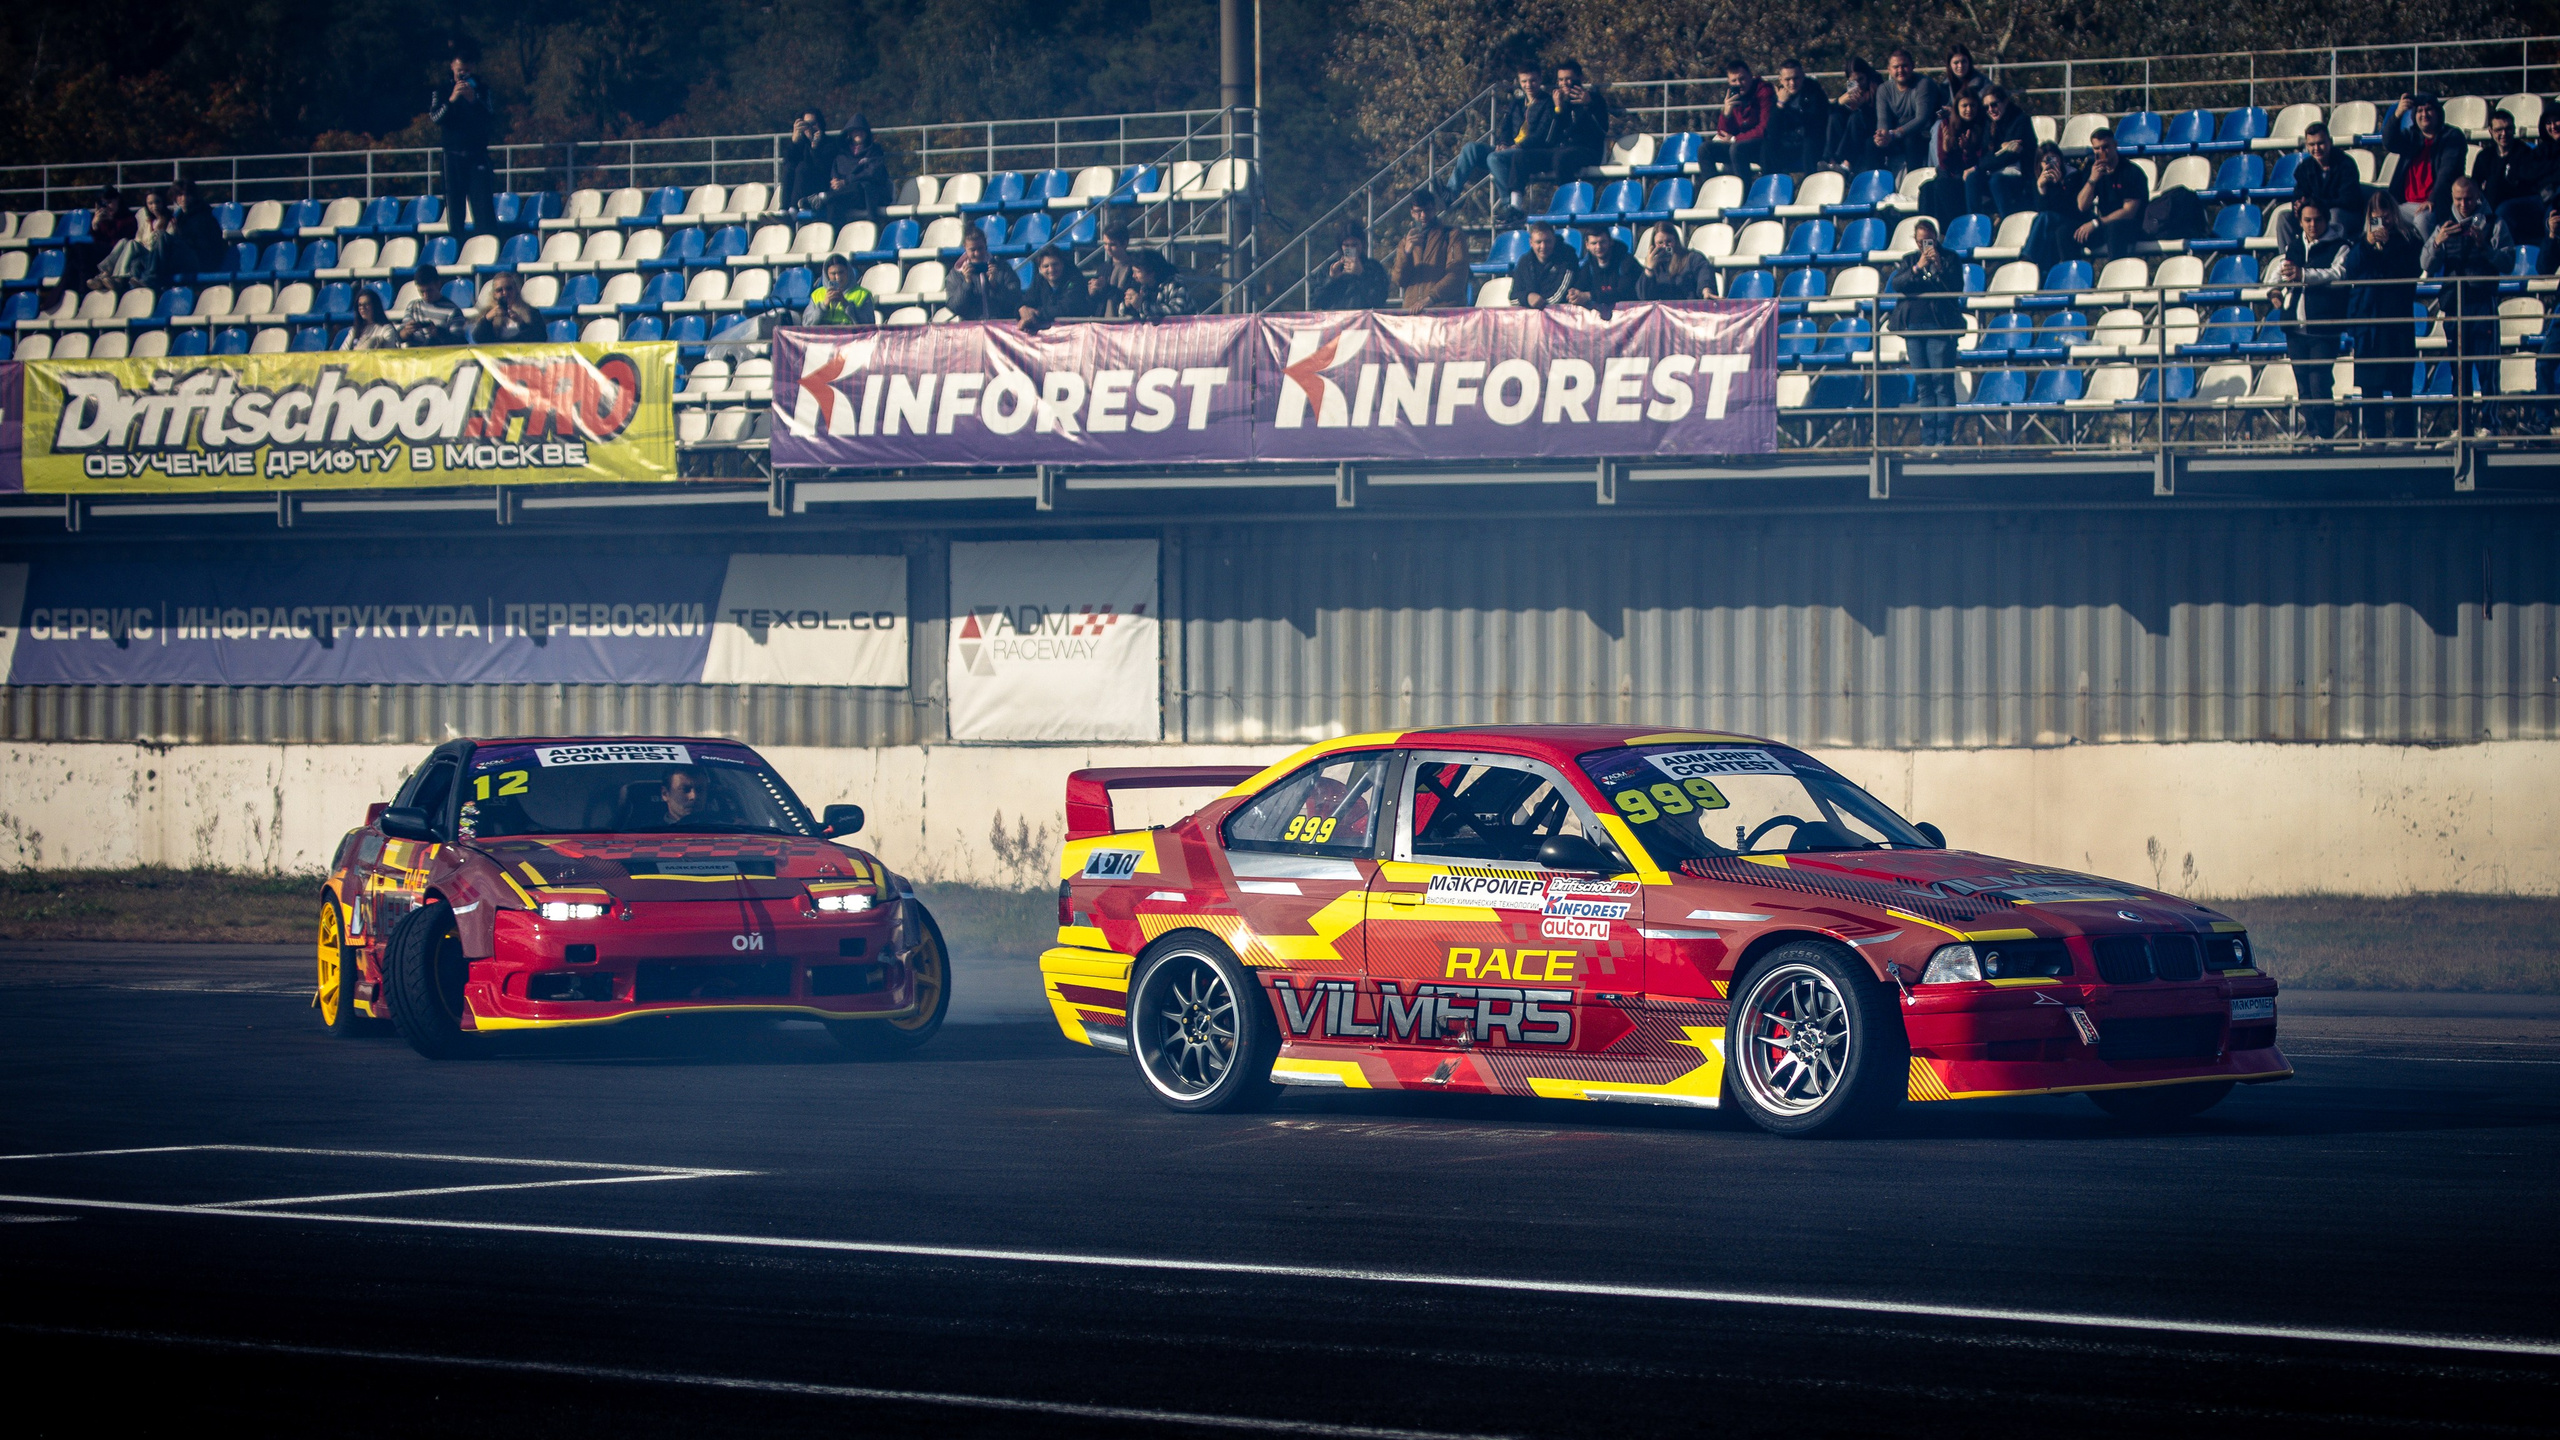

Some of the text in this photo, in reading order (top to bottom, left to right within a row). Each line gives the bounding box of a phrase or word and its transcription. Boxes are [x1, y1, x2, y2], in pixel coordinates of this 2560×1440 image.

[789, 342, 1229, 436] KINFOREST
[1274, 328, 1750, 428] KINFOREST
[54, 358, 637, 449] Driftschool.PRO
[86, 443, 588, 477] ОБУЧЕНИЕ ДРИФТУ В МОСКВЕ
[30, 603, 704, 640] СЕРВИС ИНФРАСТРУКТУРА ПЕРЕВОЗКИ
[729, 608, 895, 630] TEXOL.CO
[994, 605, 1070, 636] ADM
[993, 639, 1099, 660] RACEWAY
[549, 746, 676, 757] ADM DRIFT
[550, 753, 680, 764] CONTEST
[1661, 751, 1767, 766] ADM DRIFT
[1671, 760, 1780, 776] CONTEST
[473, 769, 529, 801] 12
[1614, 777, 1731, 825] 999
[1284, 815, 1337, 843] 999
[1426, 896, 1540, 909] ВЫСОКИЕ ХИМИЧЕСКИЕ ТЕХНОЛОГИИ
[1544, 895, 1628, 918] KINFOREST
[732, 931, 764, 951] ОЙ
[1543, 919, 1608, 938] auto.ru
[1445, 947, 1577, 982] RACE
[1274, 980, 1574, 1043] VILMERS
